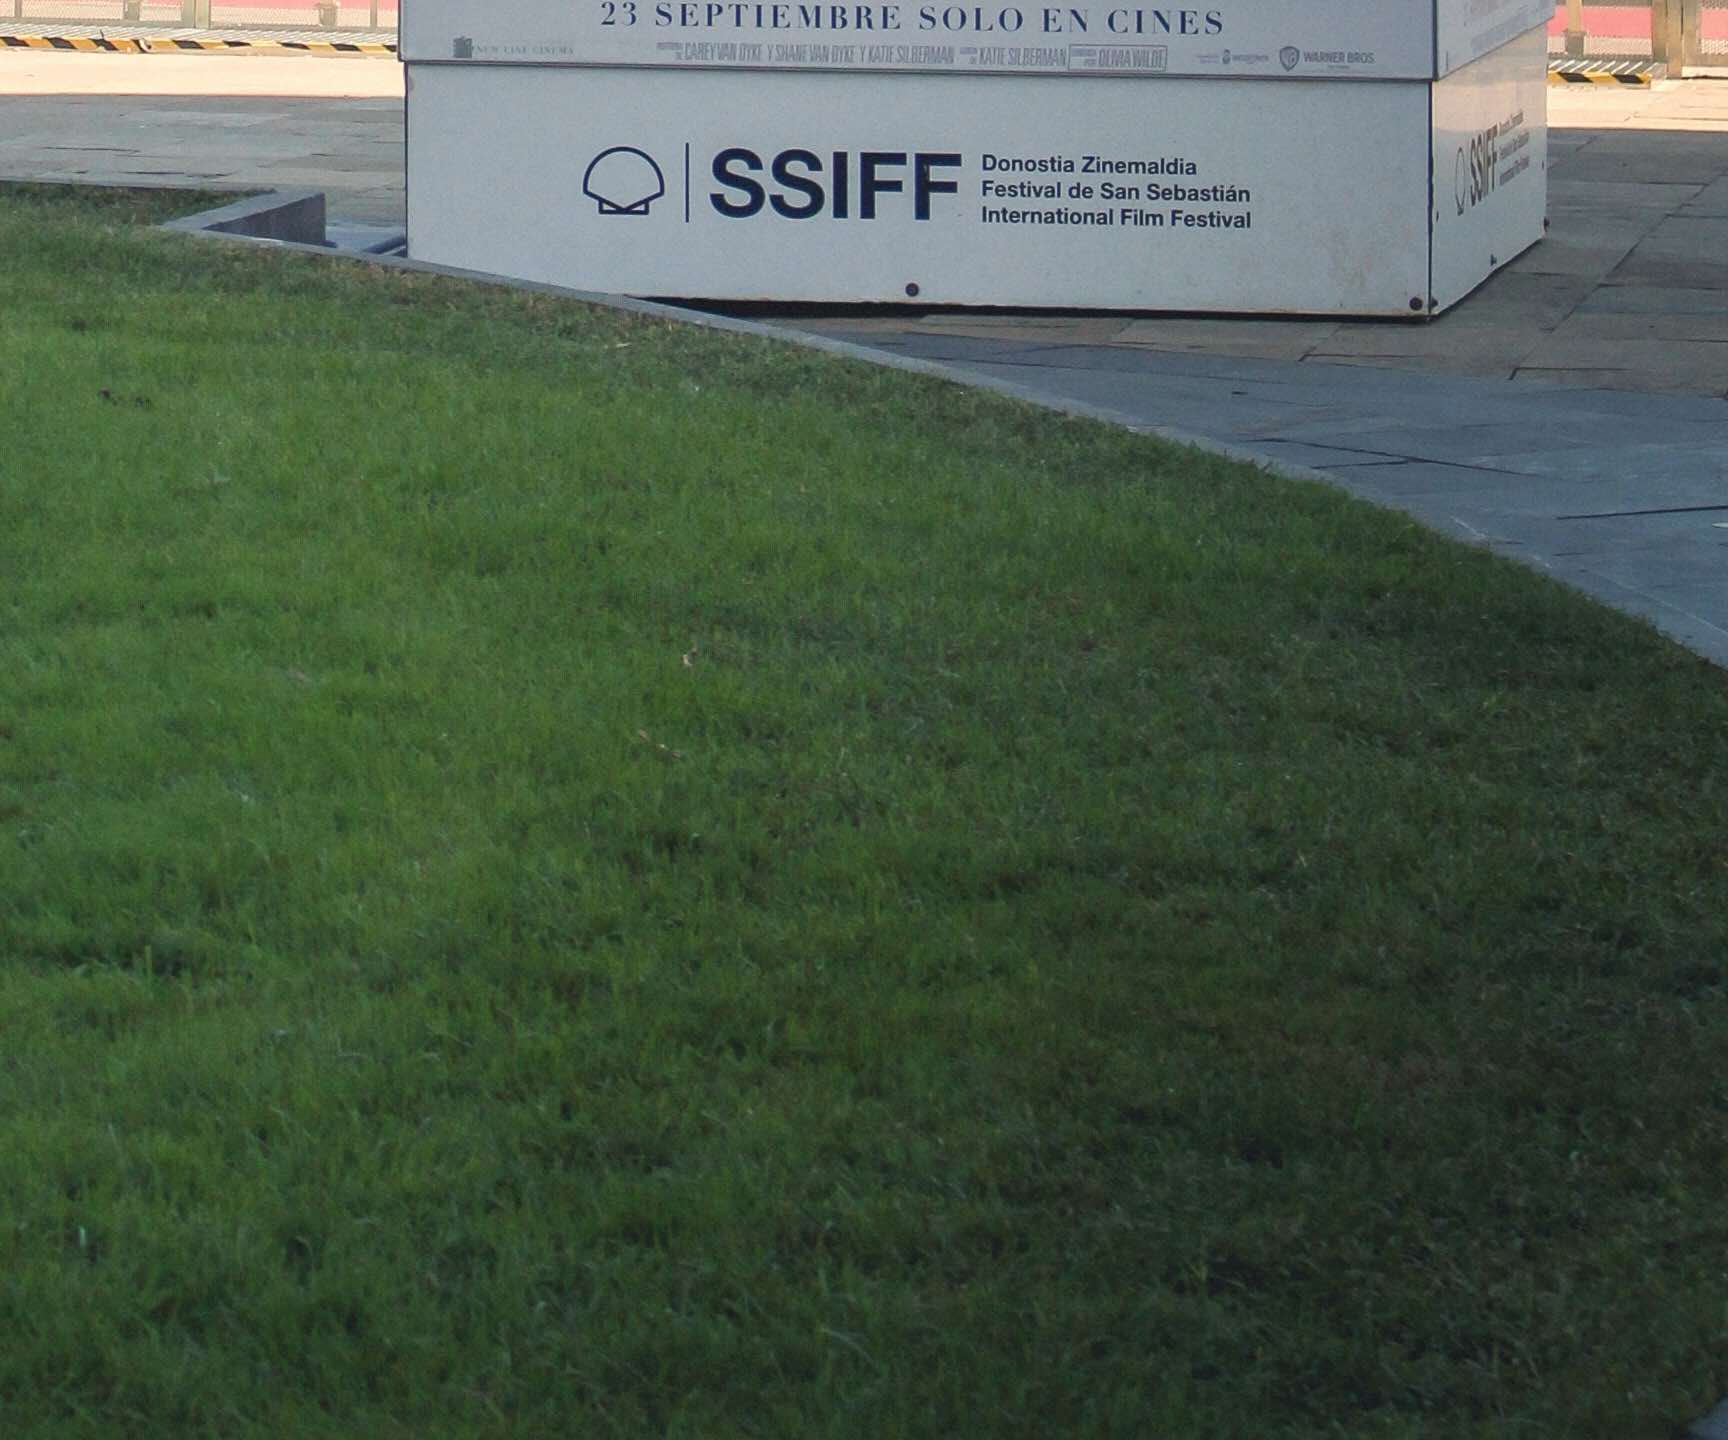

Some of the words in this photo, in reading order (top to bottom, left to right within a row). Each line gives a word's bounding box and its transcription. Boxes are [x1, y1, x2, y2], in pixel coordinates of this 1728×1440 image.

[600, 1, 638, 26] 23
[655, 2, 901, 31] SEPTIEMBRE
[919, 6, 1024, 32] SOLO
[1043, 8, 1089, 33] EN
[1107, 9, 1224, 36] CINES
[982, 153, 1075, 173] Donostia
[1080, 155, 1198, 176] Zinemaldia
[709, 147, 963, 221] SSIFF
[981, 179, 1062, 199] Festival
[1068, 181, 1094, 200] de
[1100, 181, 1140, 201] San
[1146, 182, 1251, 203] Sebastián
[981, 205, 1114, 226] International
[1120, 208, 1164, 227] Film
[1170, 209, 1252, 229] Festival
